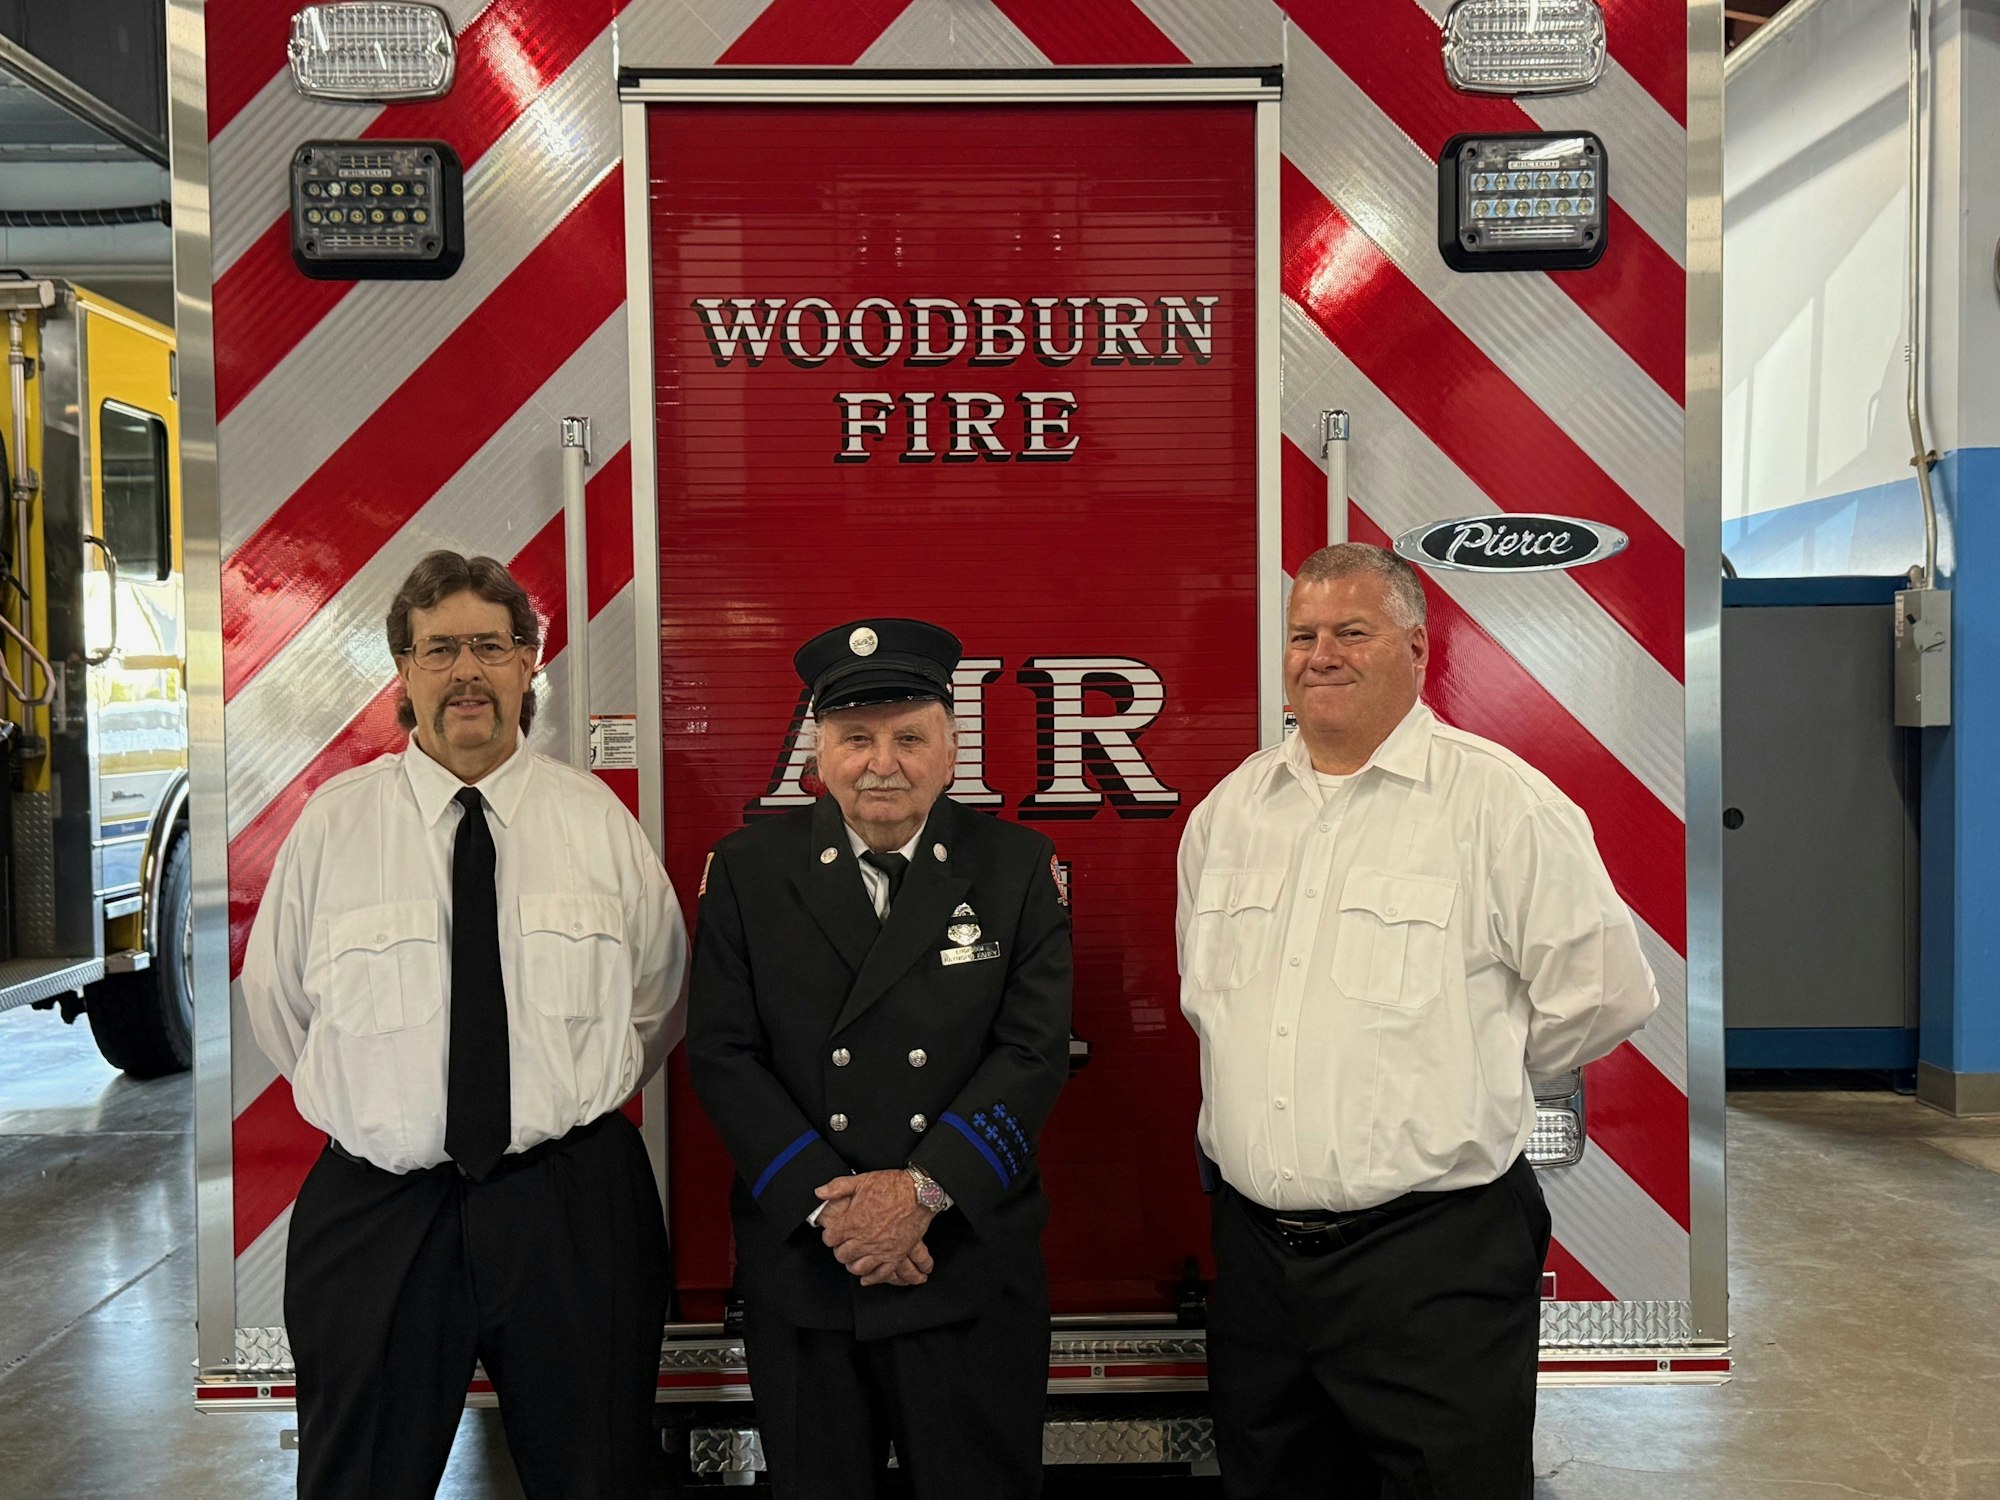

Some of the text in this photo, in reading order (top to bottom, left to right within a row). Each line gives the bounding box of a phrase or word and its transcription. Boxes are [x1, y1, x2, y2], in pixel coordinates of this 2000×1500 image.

[691, 297, 1221, 367] WOODBURN
[833, 391, 1081, 463] FIRE
[1446, 521, 1573, 562] Pierce
